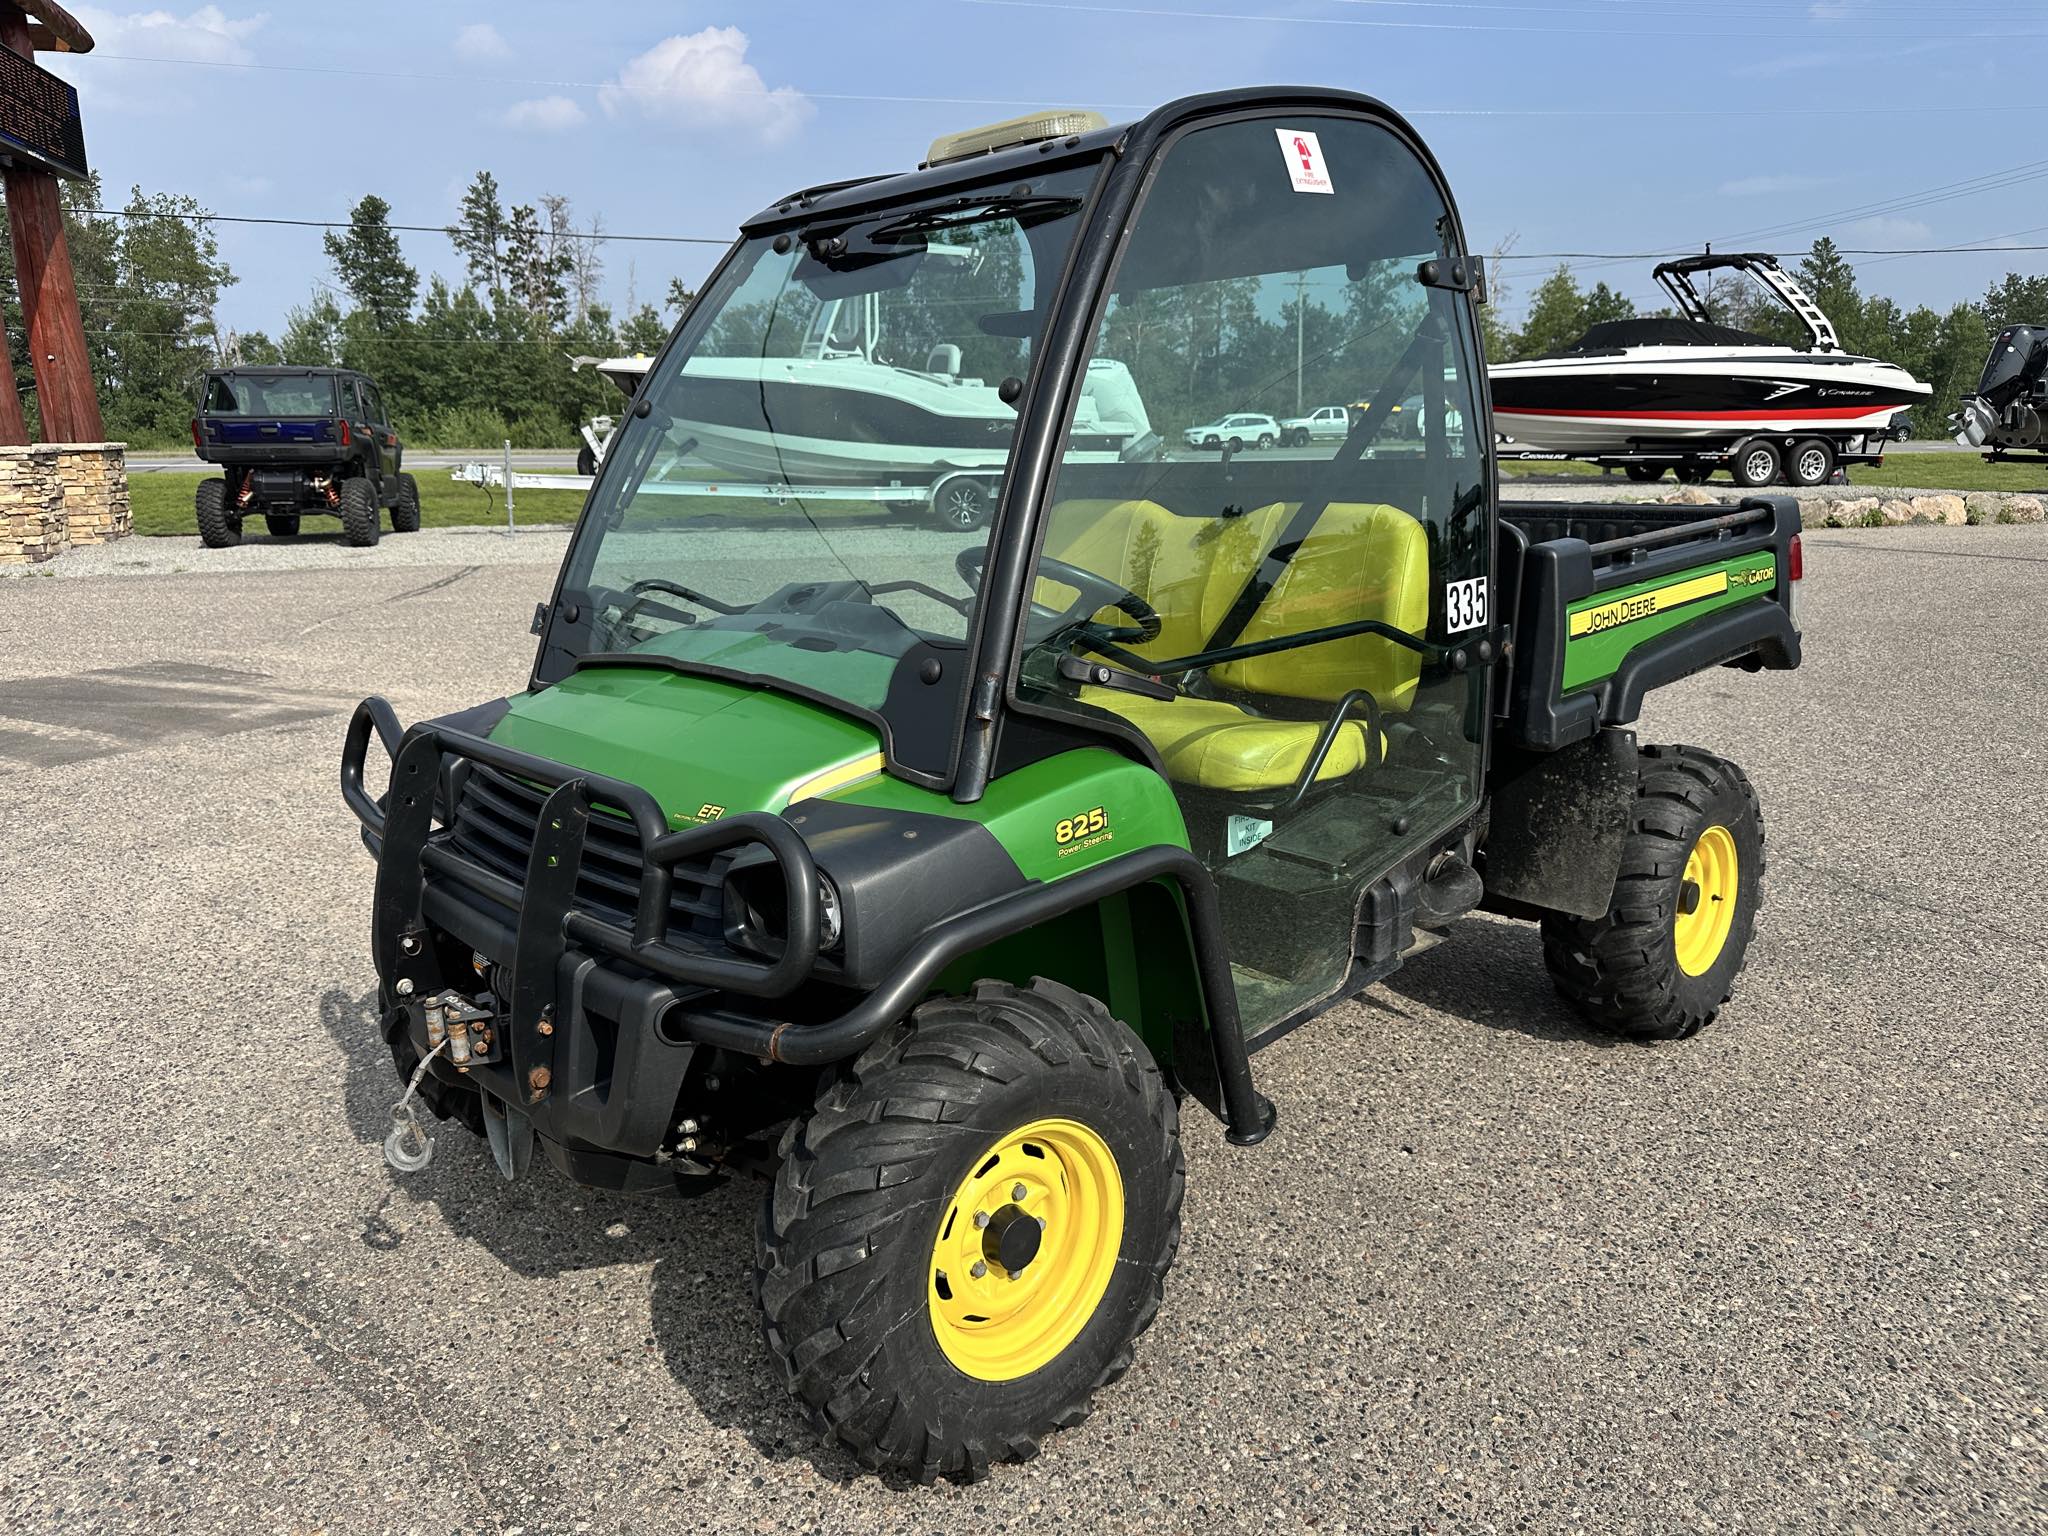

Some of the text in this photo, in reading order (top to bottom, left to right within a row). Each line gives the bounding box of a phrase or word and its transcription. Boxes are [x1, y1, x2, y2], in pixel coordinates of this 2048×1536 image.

[1748, 566, 1775, 585] GATOR
[1449, 578, 1486, 628] 335
[1586, 596, 1657, 633] JOHN DEERE
[697, 803, 726, 820] EFI
[1055, 806, 1108, 845] 825i
[1245, 822, 1256, 833] KIT
[1058, 831, 1113, 857] Power Steering
[1239, 832, 1262, 847] INSIDE
